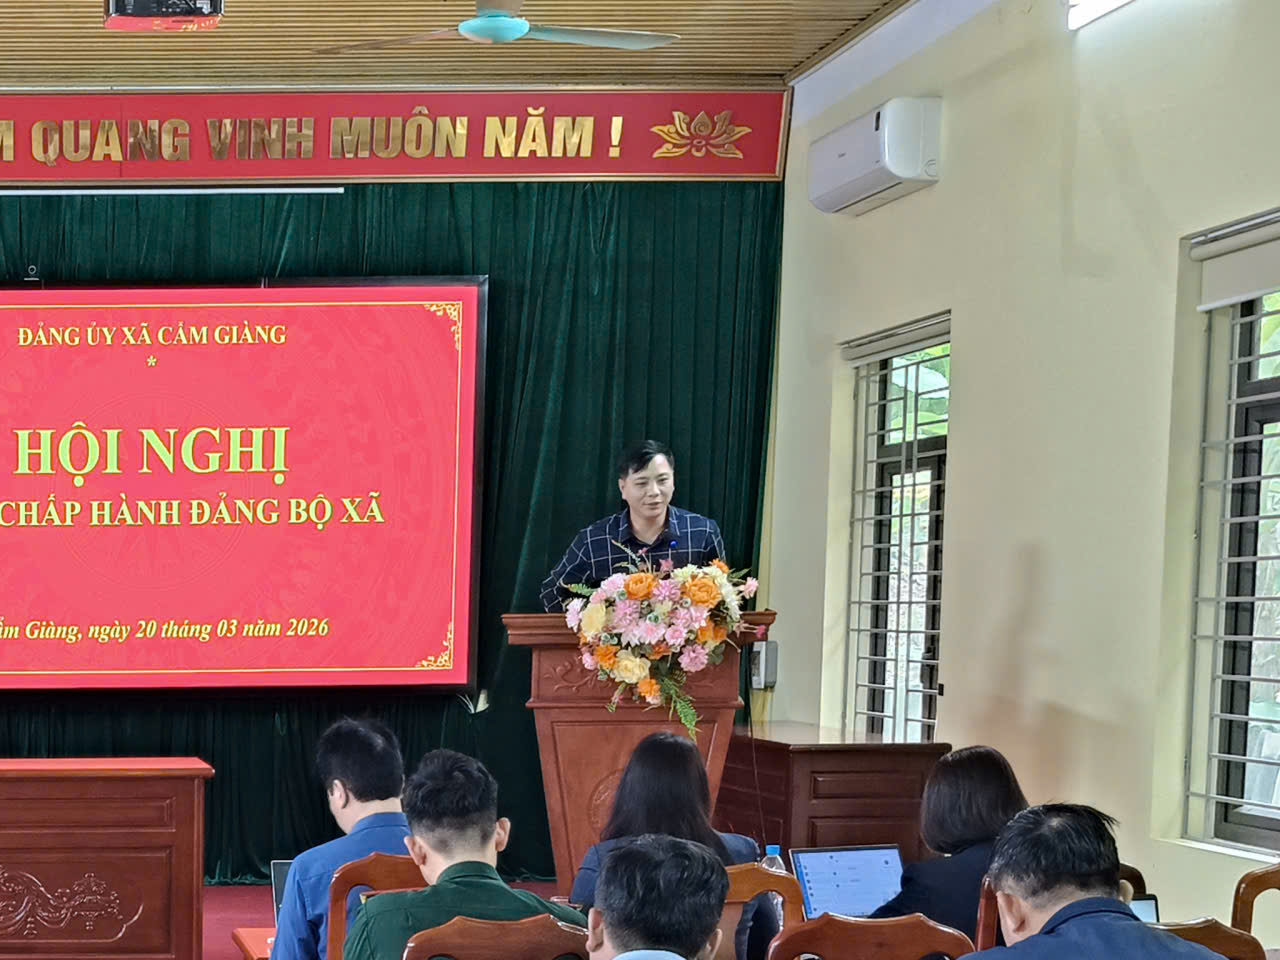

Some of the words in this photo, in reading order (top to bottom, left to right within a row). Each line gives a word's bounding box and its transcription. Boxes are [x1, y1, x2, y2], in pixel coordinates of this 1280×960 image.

[30, 119, 191, 167] QUANG
[206, 117, 315, 161] VINH
[330, 106, 468, 159] MUÔN
[484, 105, 595, 158] NĂM
[608, 116, 624, 158] !
[17, 321, 80, 346] ĐẢNG
[86, 321, 117, 346] ỦY
[121, 321, 153, 346] XÃ
[157, 321, 209, 346] CẨM
[213, 320, 287, 345] GIÀNG
[12, 420, 123, 488] HỘI
[137, 426, 291, 485] NGHỊ
[89, 492, 182, 527] HÀNH
[188, 491, 280, 526] ĐẢNG
[287, 493, 333, 531] BỘ
[339, 491, 386, 524] XÃ
[24, 620, 83, 644] Giàng,
[87, 620, 131, 643] ngày
[135, 619, 157, 640] 20
[160, 618, 213, 643] tháng
[216, 618, 238, 638] 03
[242, 618, 282, 638] năm
[285, 617, 330, 637] 2026
